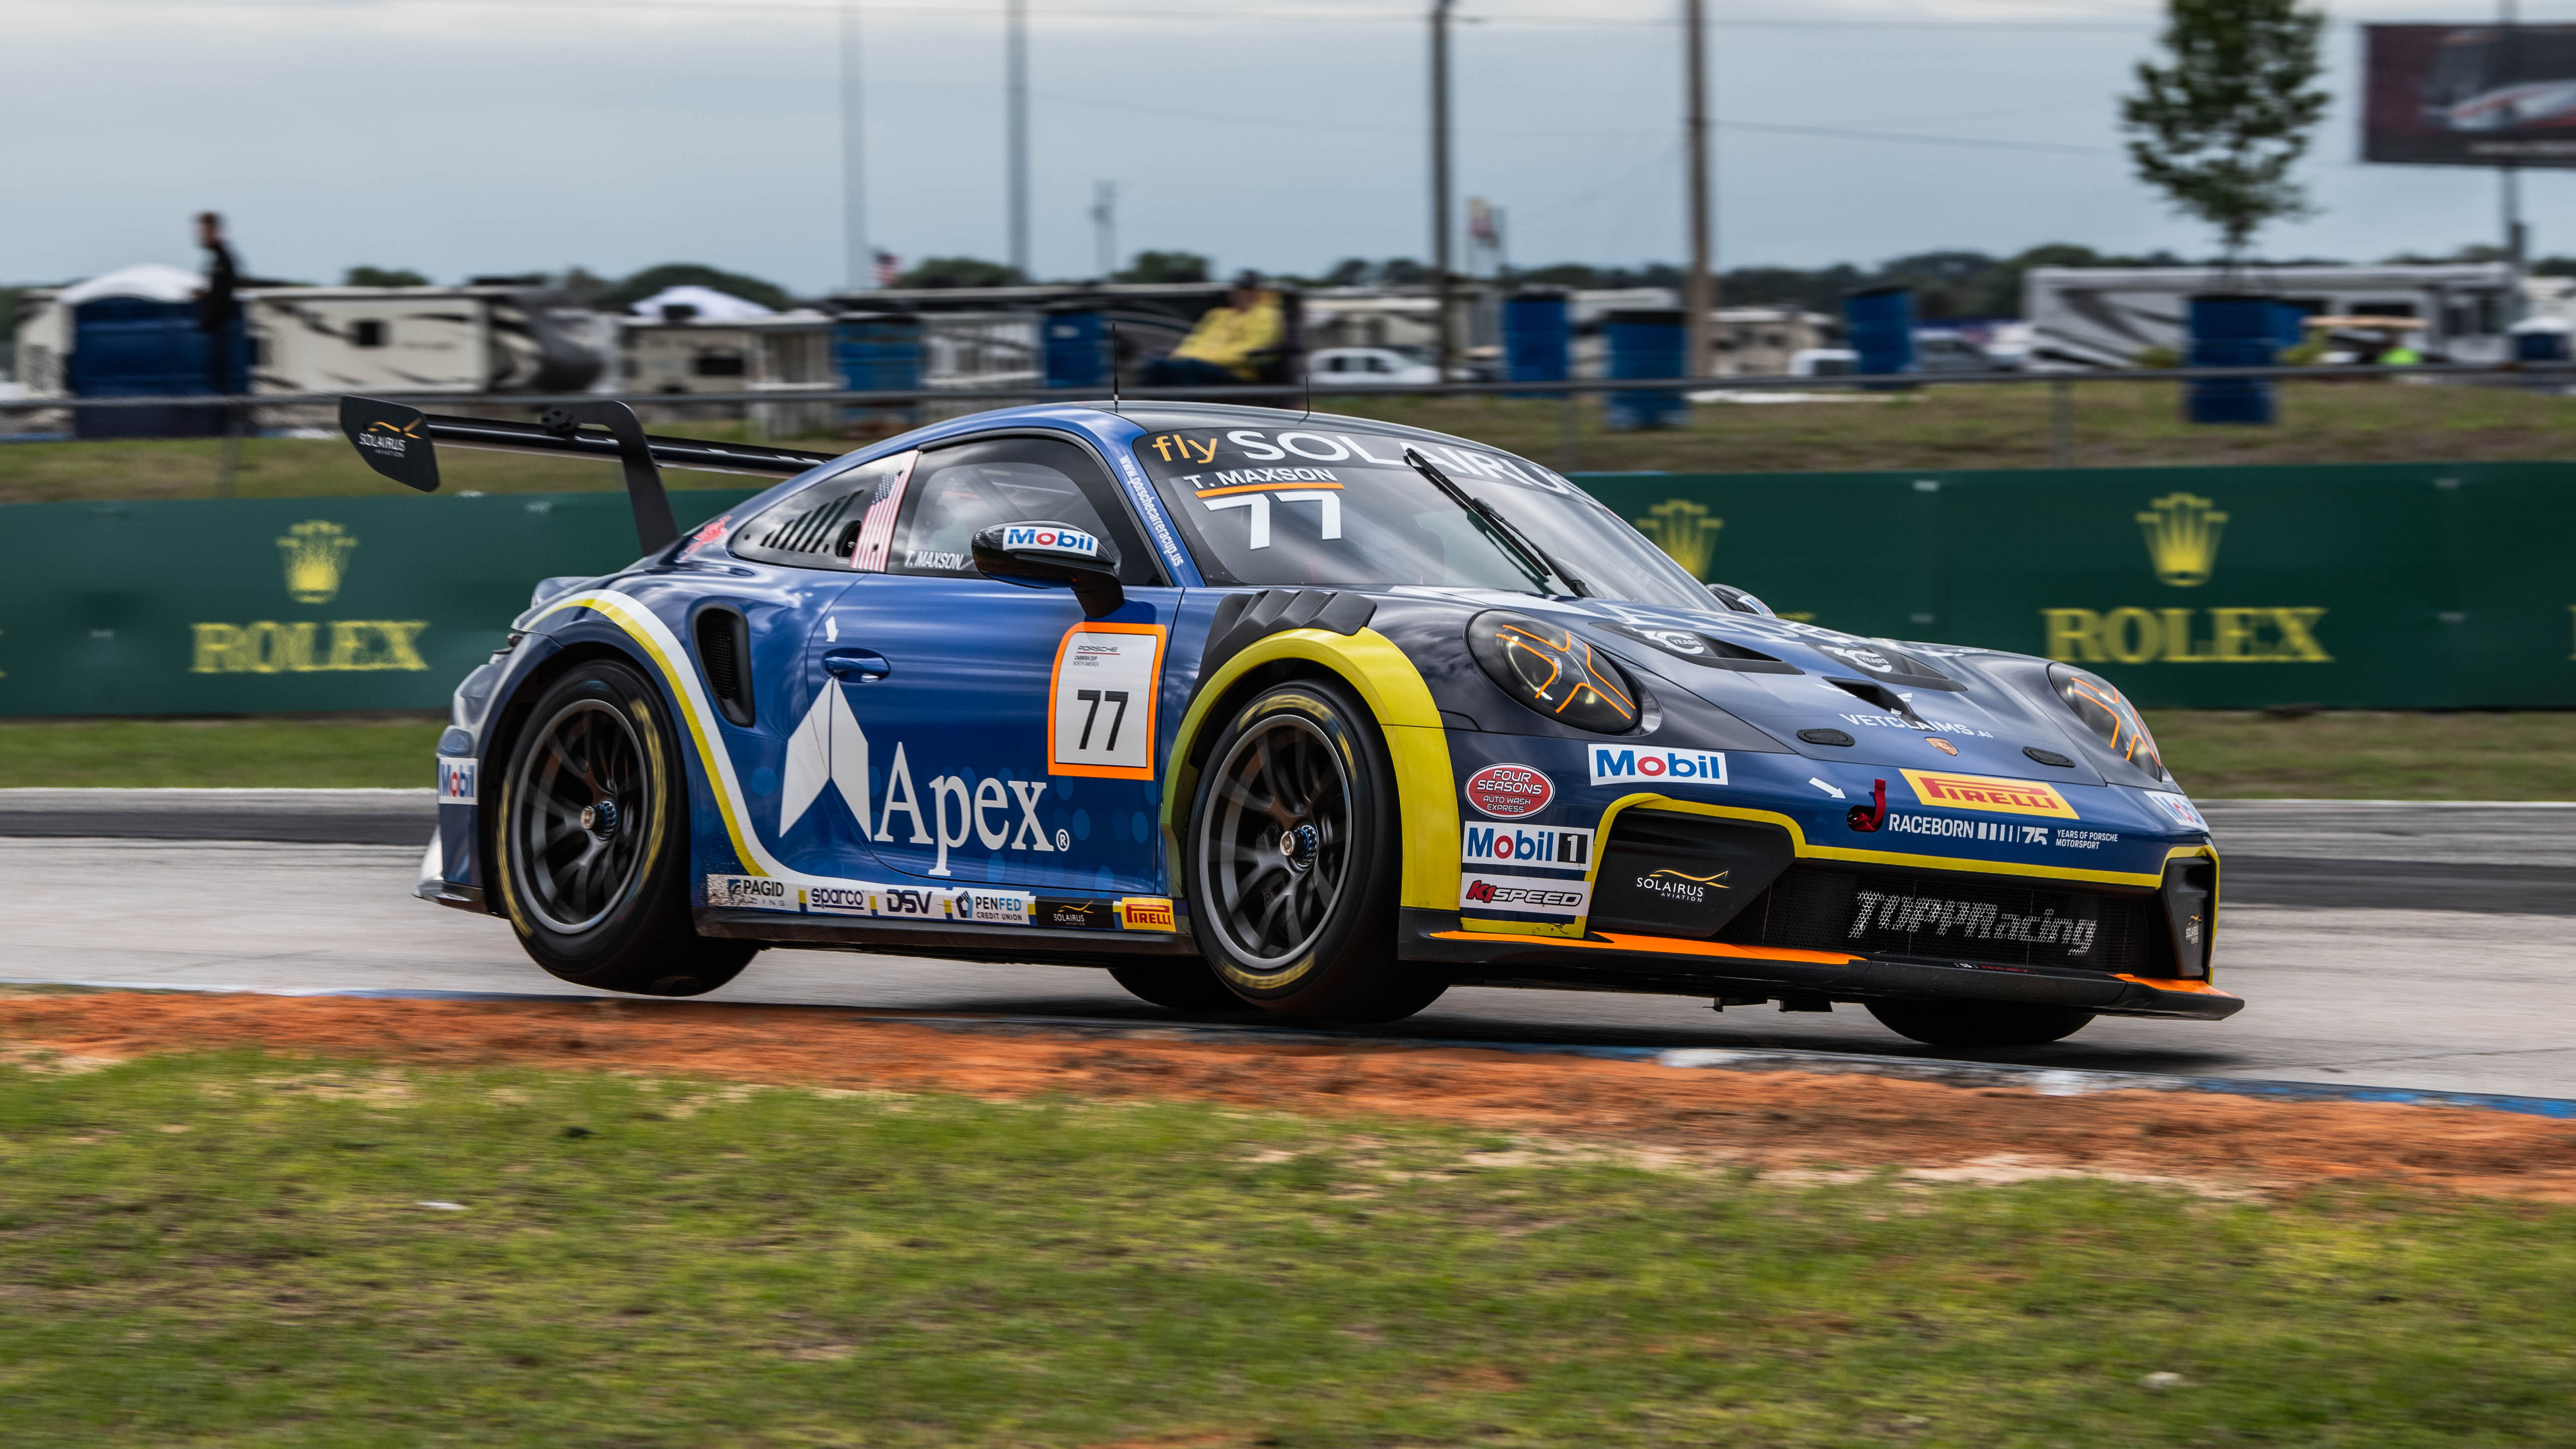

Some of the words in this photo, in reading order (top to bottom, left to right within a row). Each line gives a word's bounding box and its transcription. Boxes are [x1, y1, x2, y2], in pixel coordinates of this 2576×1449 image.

[1152, 434, 1217, 464] fly
[1215, 468, 1337, 485] MAXSON
[1119, 455, 1183, 567] www.porschecarreracup.us
[1203, 491, 1341, 550] 77
[1008, 529, 1093, 551] Mobil
[191, 621, 430, 673] ROLEX
[2041, 607, 2333, 663] ROLEX
[1077, 689, 1129, 751] 77
[1493, 770, 1532, 783] FOUR
[1596, 750, 1720, 779] Mobil
[1477, 780, 1543, 794] SEASONS
[1919, 777, 2060, 809] PIRELLI
[1507, 797, 1531, 805] WASH
[1889, 813, 1974, 839] RACEBORN
[2022, 826, 2048, 845] 75
[2057, 829, 2078, 838] YEARS
[2079, 831, 2087, 839] OF
[2089, 832, 2118, 842] PORSCHE
[1467, 827, 1554, 861] Mobil
[1567, 835, 1578, 862] 1
[2056, 839, 2100, 849] MOTORSPORT
[1636, 878, 1704, 897] SOLAIRUS
[1661, 892, 1702, 902] AVIATION
[743, 879, 784, 897] PAGID
[811, 888, 864, 909] sparco
[887, 889, 932, 914] DSV
[976, 896, 1022, 911] PENFED
[1126, 904, 1171, 925] PIRELLI
[977, 912, 999, 920] CREDIT
[1053, 914, 1085, 922] SOLAIRUS
